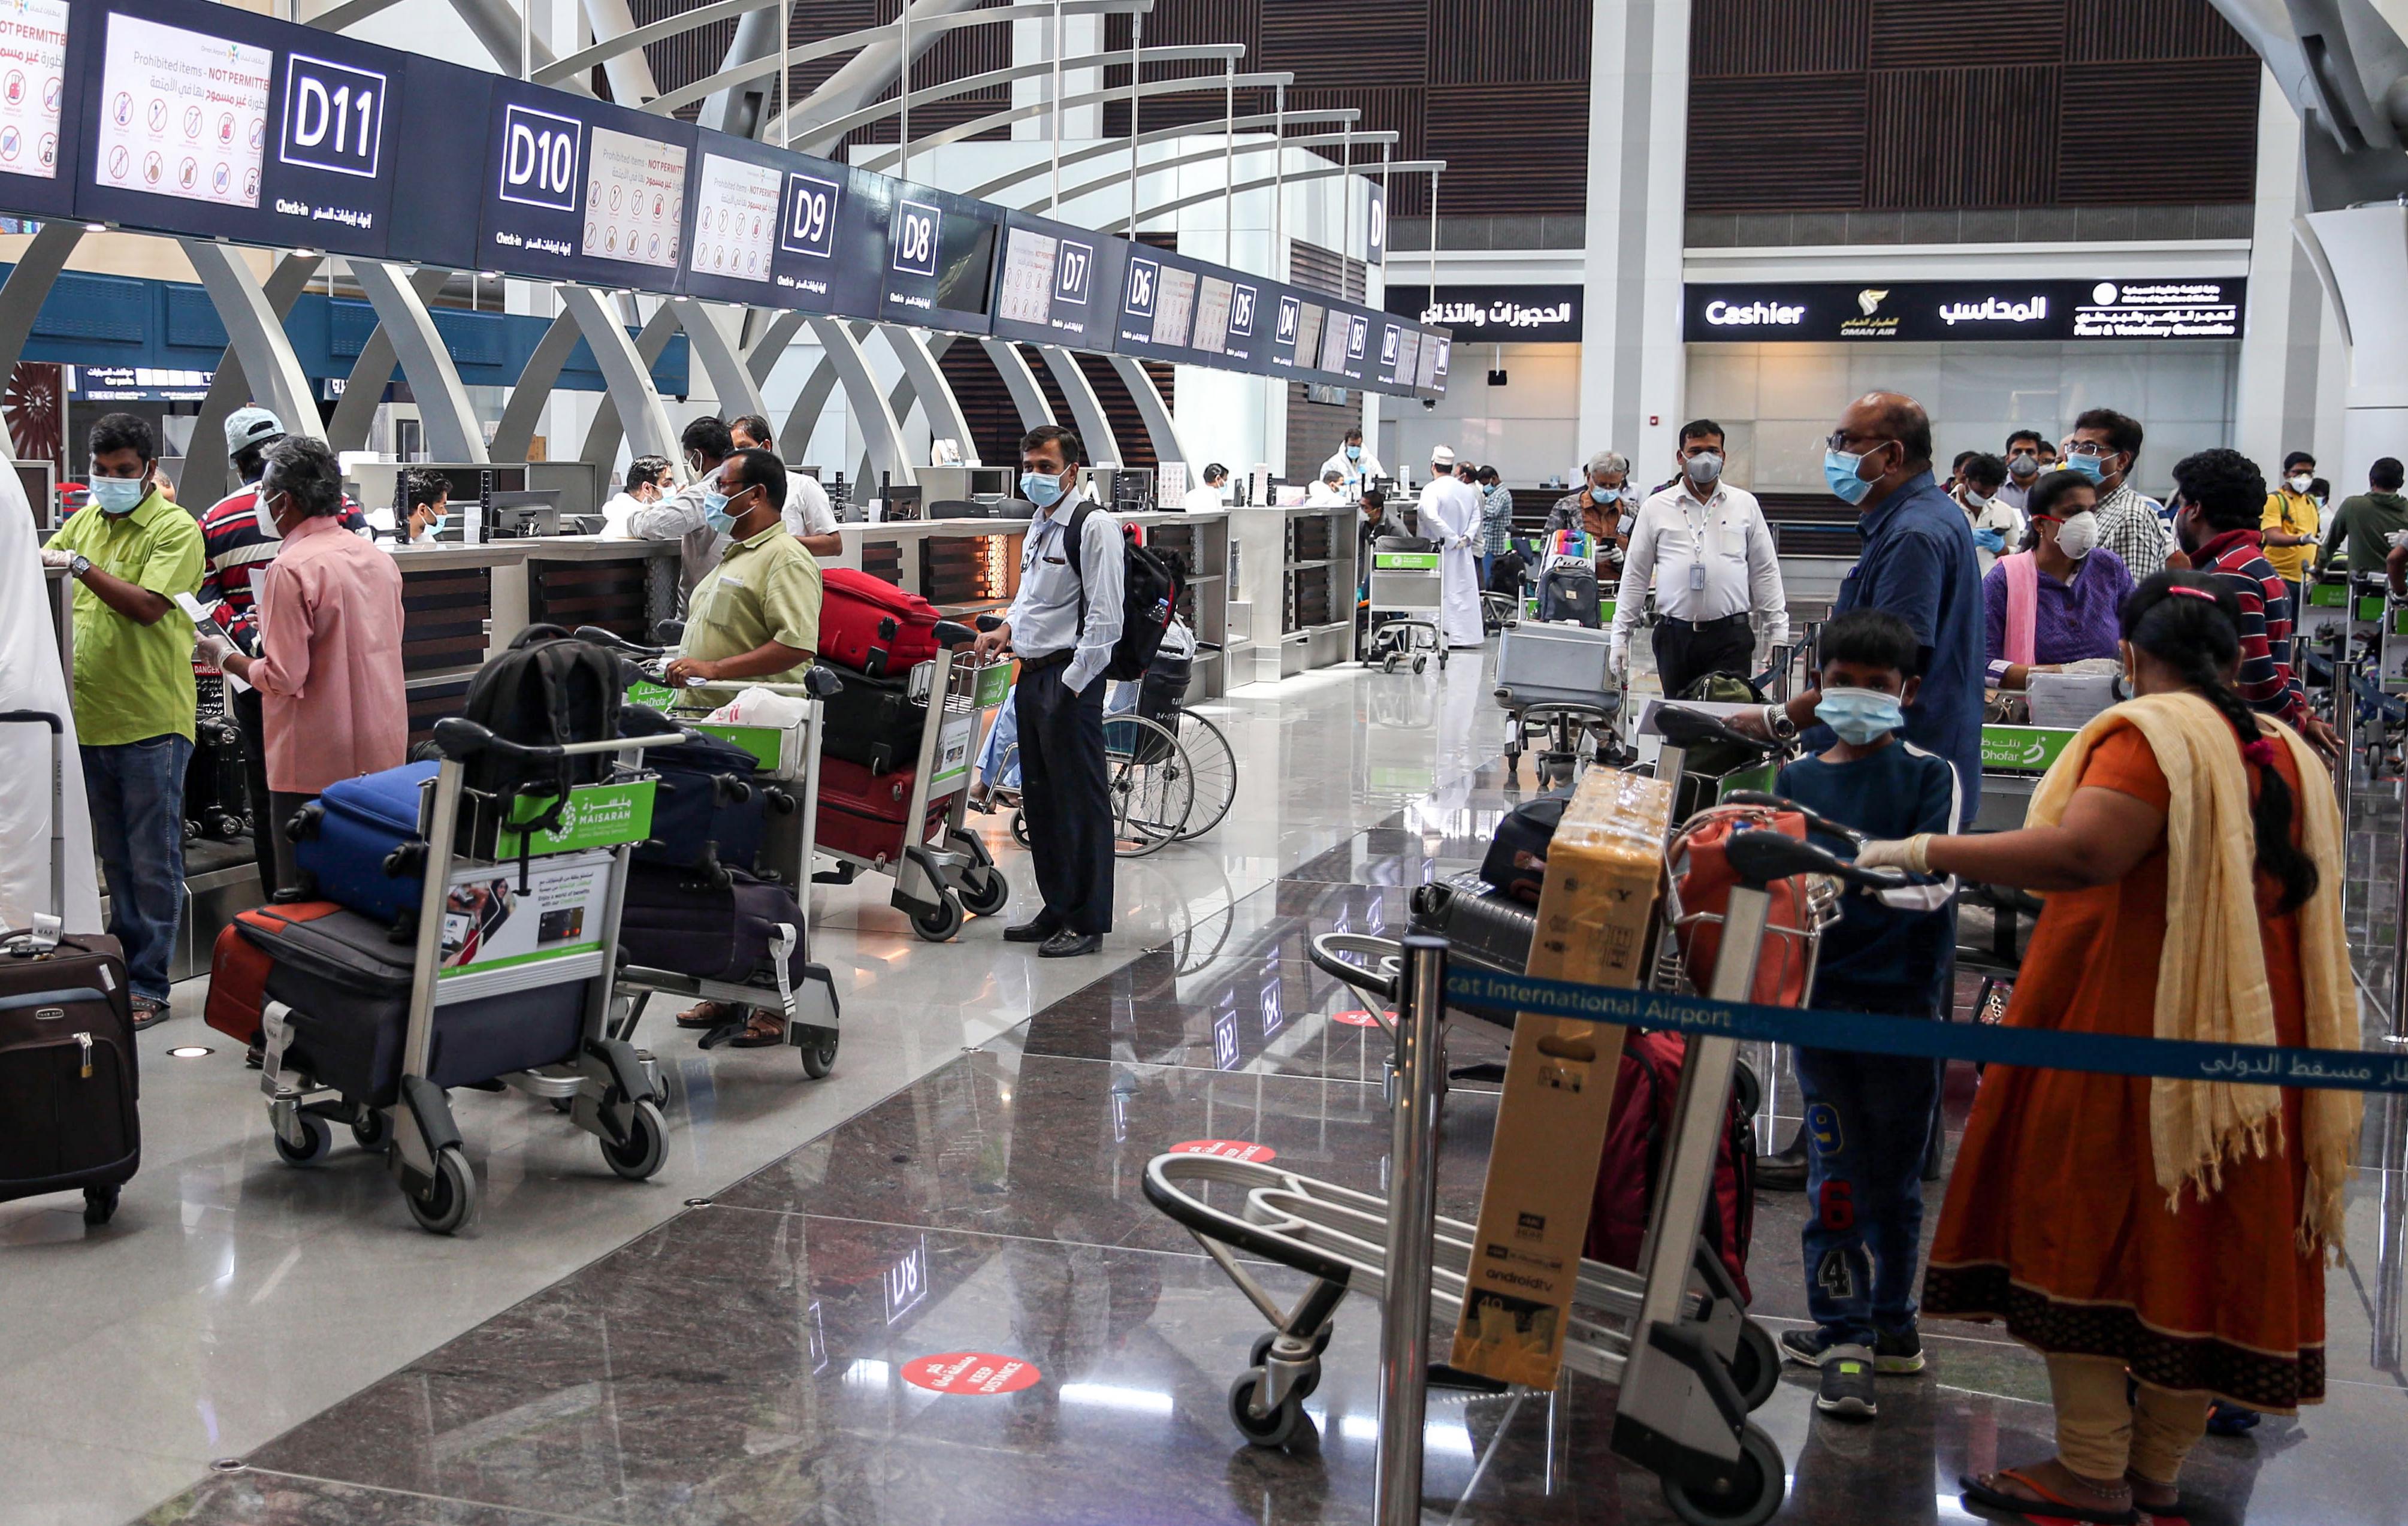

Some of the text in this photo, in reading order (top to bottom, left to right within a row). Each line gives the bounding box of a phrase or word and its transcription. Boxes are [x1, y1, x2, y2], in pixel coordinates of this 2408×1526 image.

[134, 51, 178, 72] Prohibited
[179, 61, 203, 77] items
[209, 67, 227, 82] NOT
[178, 86, 191, 98] في
[192, 84, 204, 101] بها
[205, 89, 234, 105] مسموح
[235, 93, 247, 108] غير
[295, 77, 373, 156] D11
[509, 123, 572, 194] D10
[603, 149, 630, 164] Prohibited
[630, 155, 645, 167] items
[648, 159, 660, 170] NOT
[750, 185, 760, 196] NOT
[276, 199, 309, 216] Check-in
[312, 207, 334, 220] السفر
[793, 189, 826, 243] D9
[1371, 199, 1382, 247] D
[496, 232, 522, 246] Check-in
[525, 238, 542, 250] السفر
[903, 214, 930, 262] D8
[1062, 252, 1086, 292] D7
[1131, 268, 1152, 307] D6
[1234, 293, 1252, 327] D5
[1280, 304, 1295, 336] D4
[1489, 301, 1570, 328] الحجوزات
[1706, 301, 1805, 325] Cashier
[1939, 296, 2047, 326] المحاسب
[1351, 323, 1364, 352] D3
[1384, 331, 1397, 358] D2
[1438, 344, 1447, 368] D1
[1981, 749, 2019, 762] Dhofar
[579, 809, 631, 825] MAISARAH
[582, 794, 632, 814] ميسرة
[1446, 975, 1732, 1027] cat International Airport
[2200, 1050, 2280, 1077] الدولي
[2288, 1054, 2373, 1080] مسقط
[1808, 1103, 1844, 1155] 9
[1819, 1179, 1854, 1231] 6
[1818, 1250, 1854, 1298] 4
[967, 1366, 995, 1383] KEEP
[979, 1361, 1023, 1392] DISTANCE
